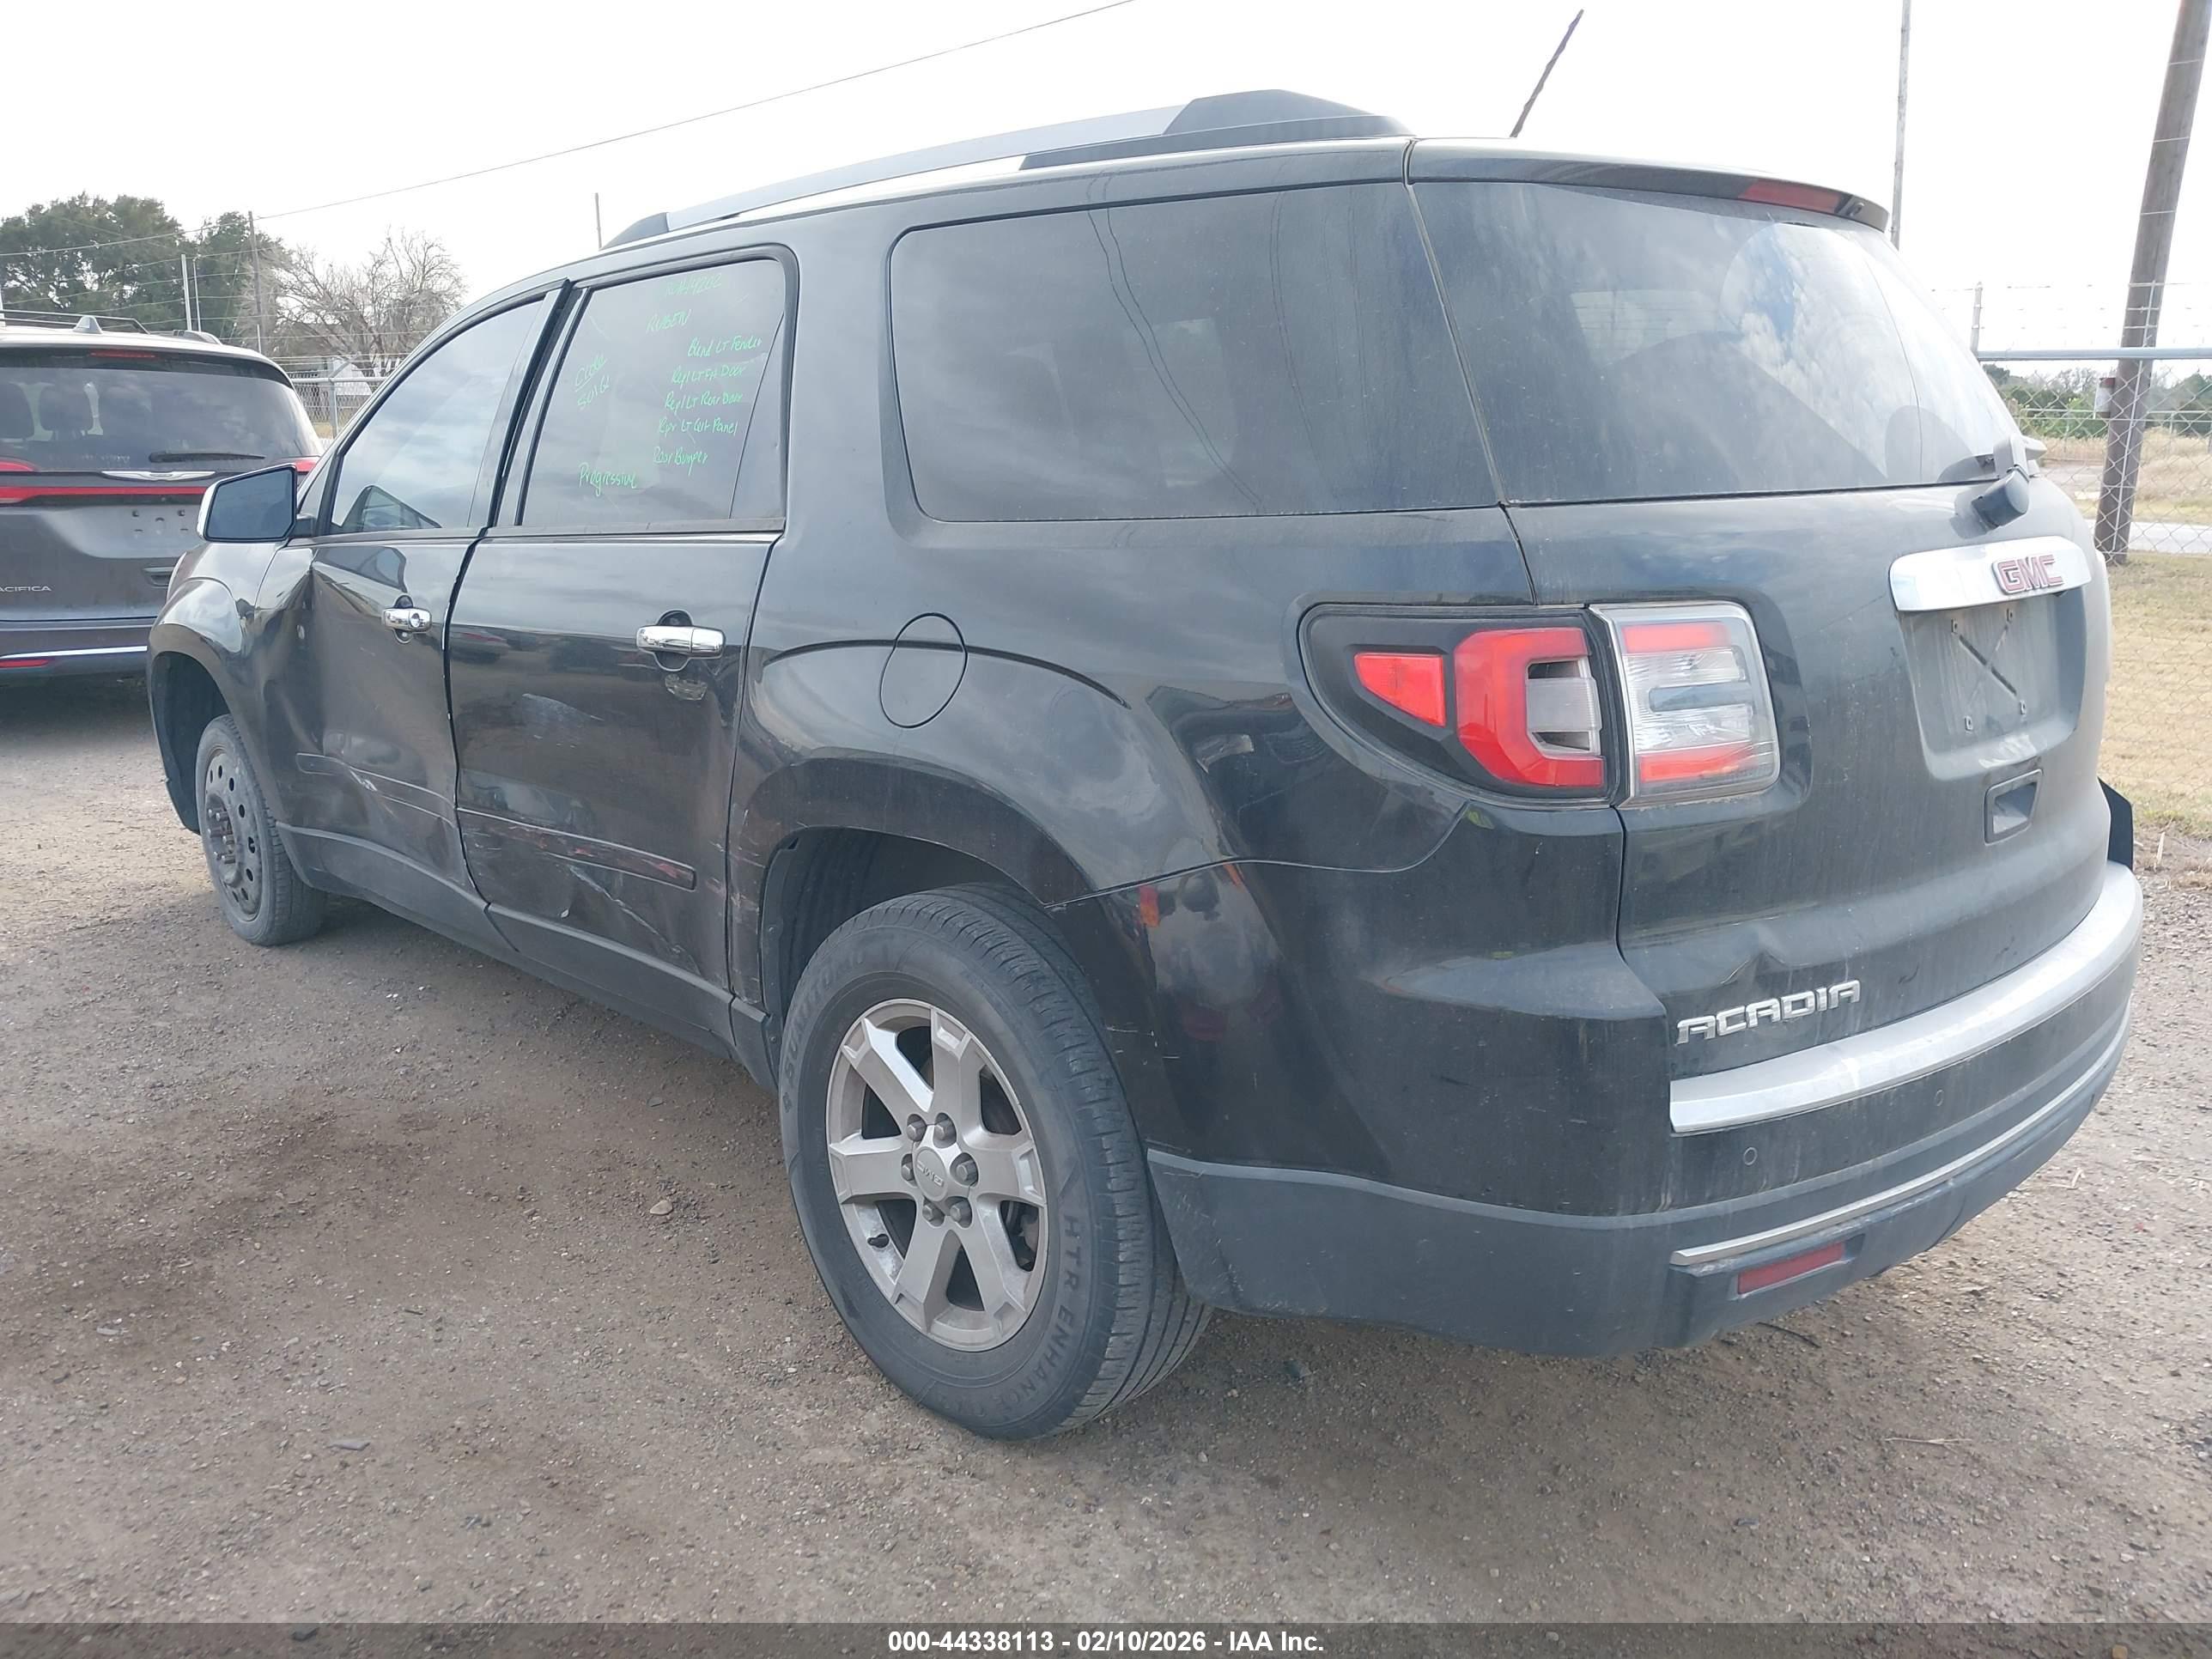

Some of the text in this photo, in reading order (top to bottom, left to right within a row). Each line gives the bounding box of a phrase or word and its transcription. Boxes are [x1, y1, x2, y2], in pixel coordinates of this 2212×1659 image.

[713, 417, 738, 436] Panel
[1994, 554, 2064, 593] GMC
[1676, 980, 1861, 1045] ACADIA
[916, 1159, 944, 1187] GMC
[1064, 1214, 1079, 1293] HTR
